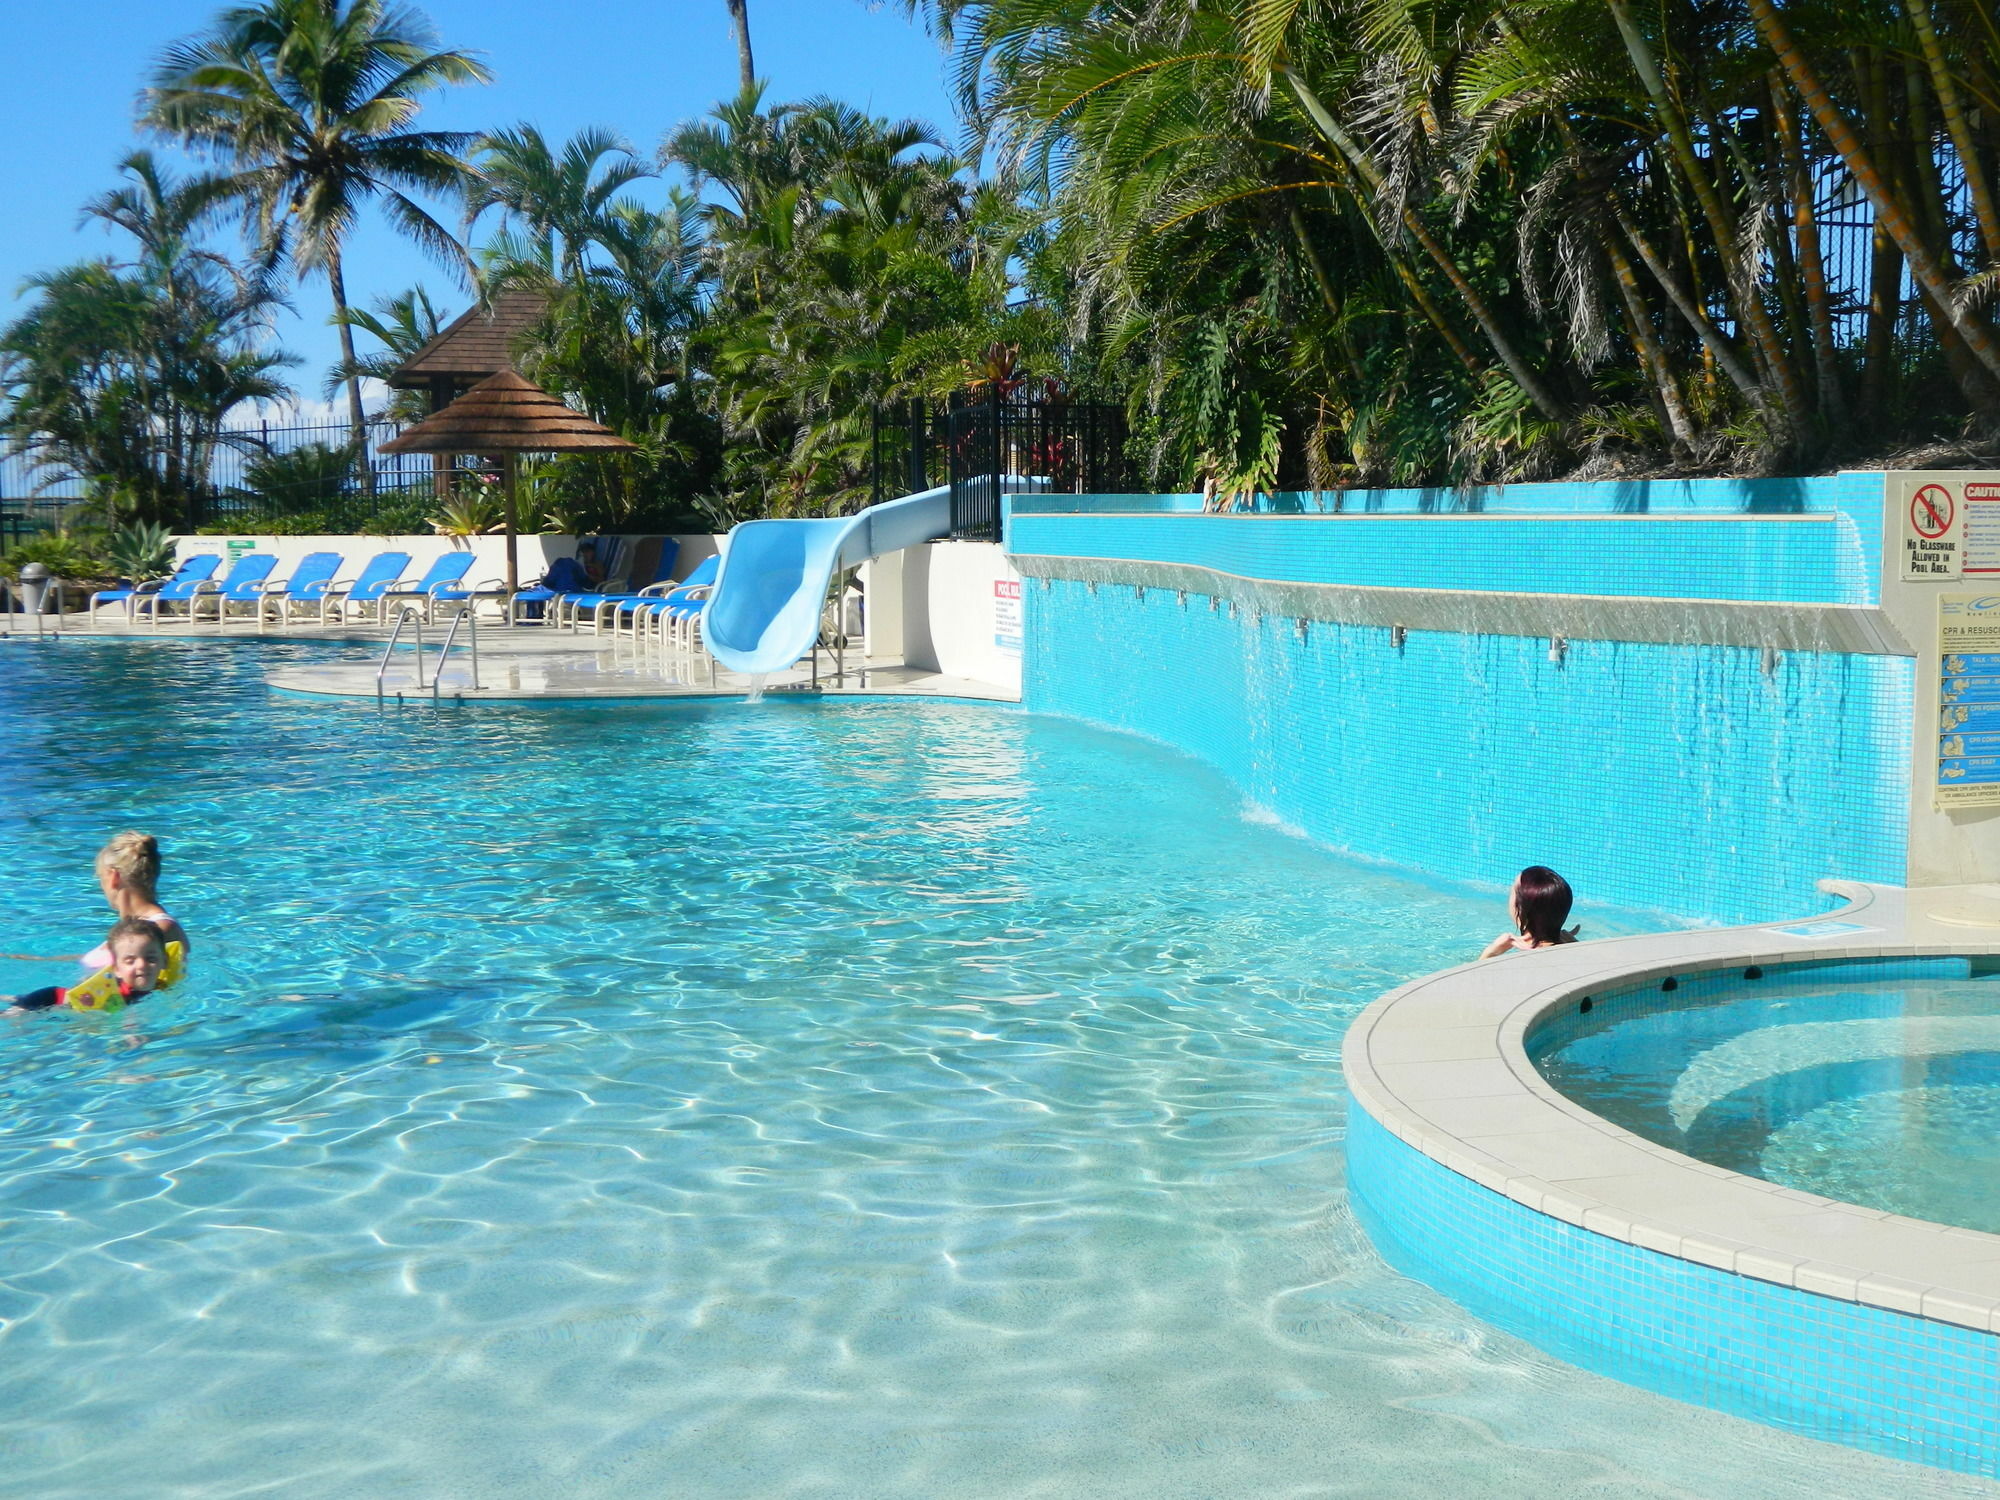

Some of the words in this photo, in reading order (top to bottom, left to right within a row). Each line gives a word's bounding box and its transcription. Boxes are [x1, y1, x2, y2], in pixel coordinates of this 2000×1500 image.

[1920, 539, 1956, 551] GLASSWARE
[1912, 550, 1940, 561] ALLOWED
[1912, 562, 1928, 573] POOL
[1943, 627, 1958, 635] CPR
